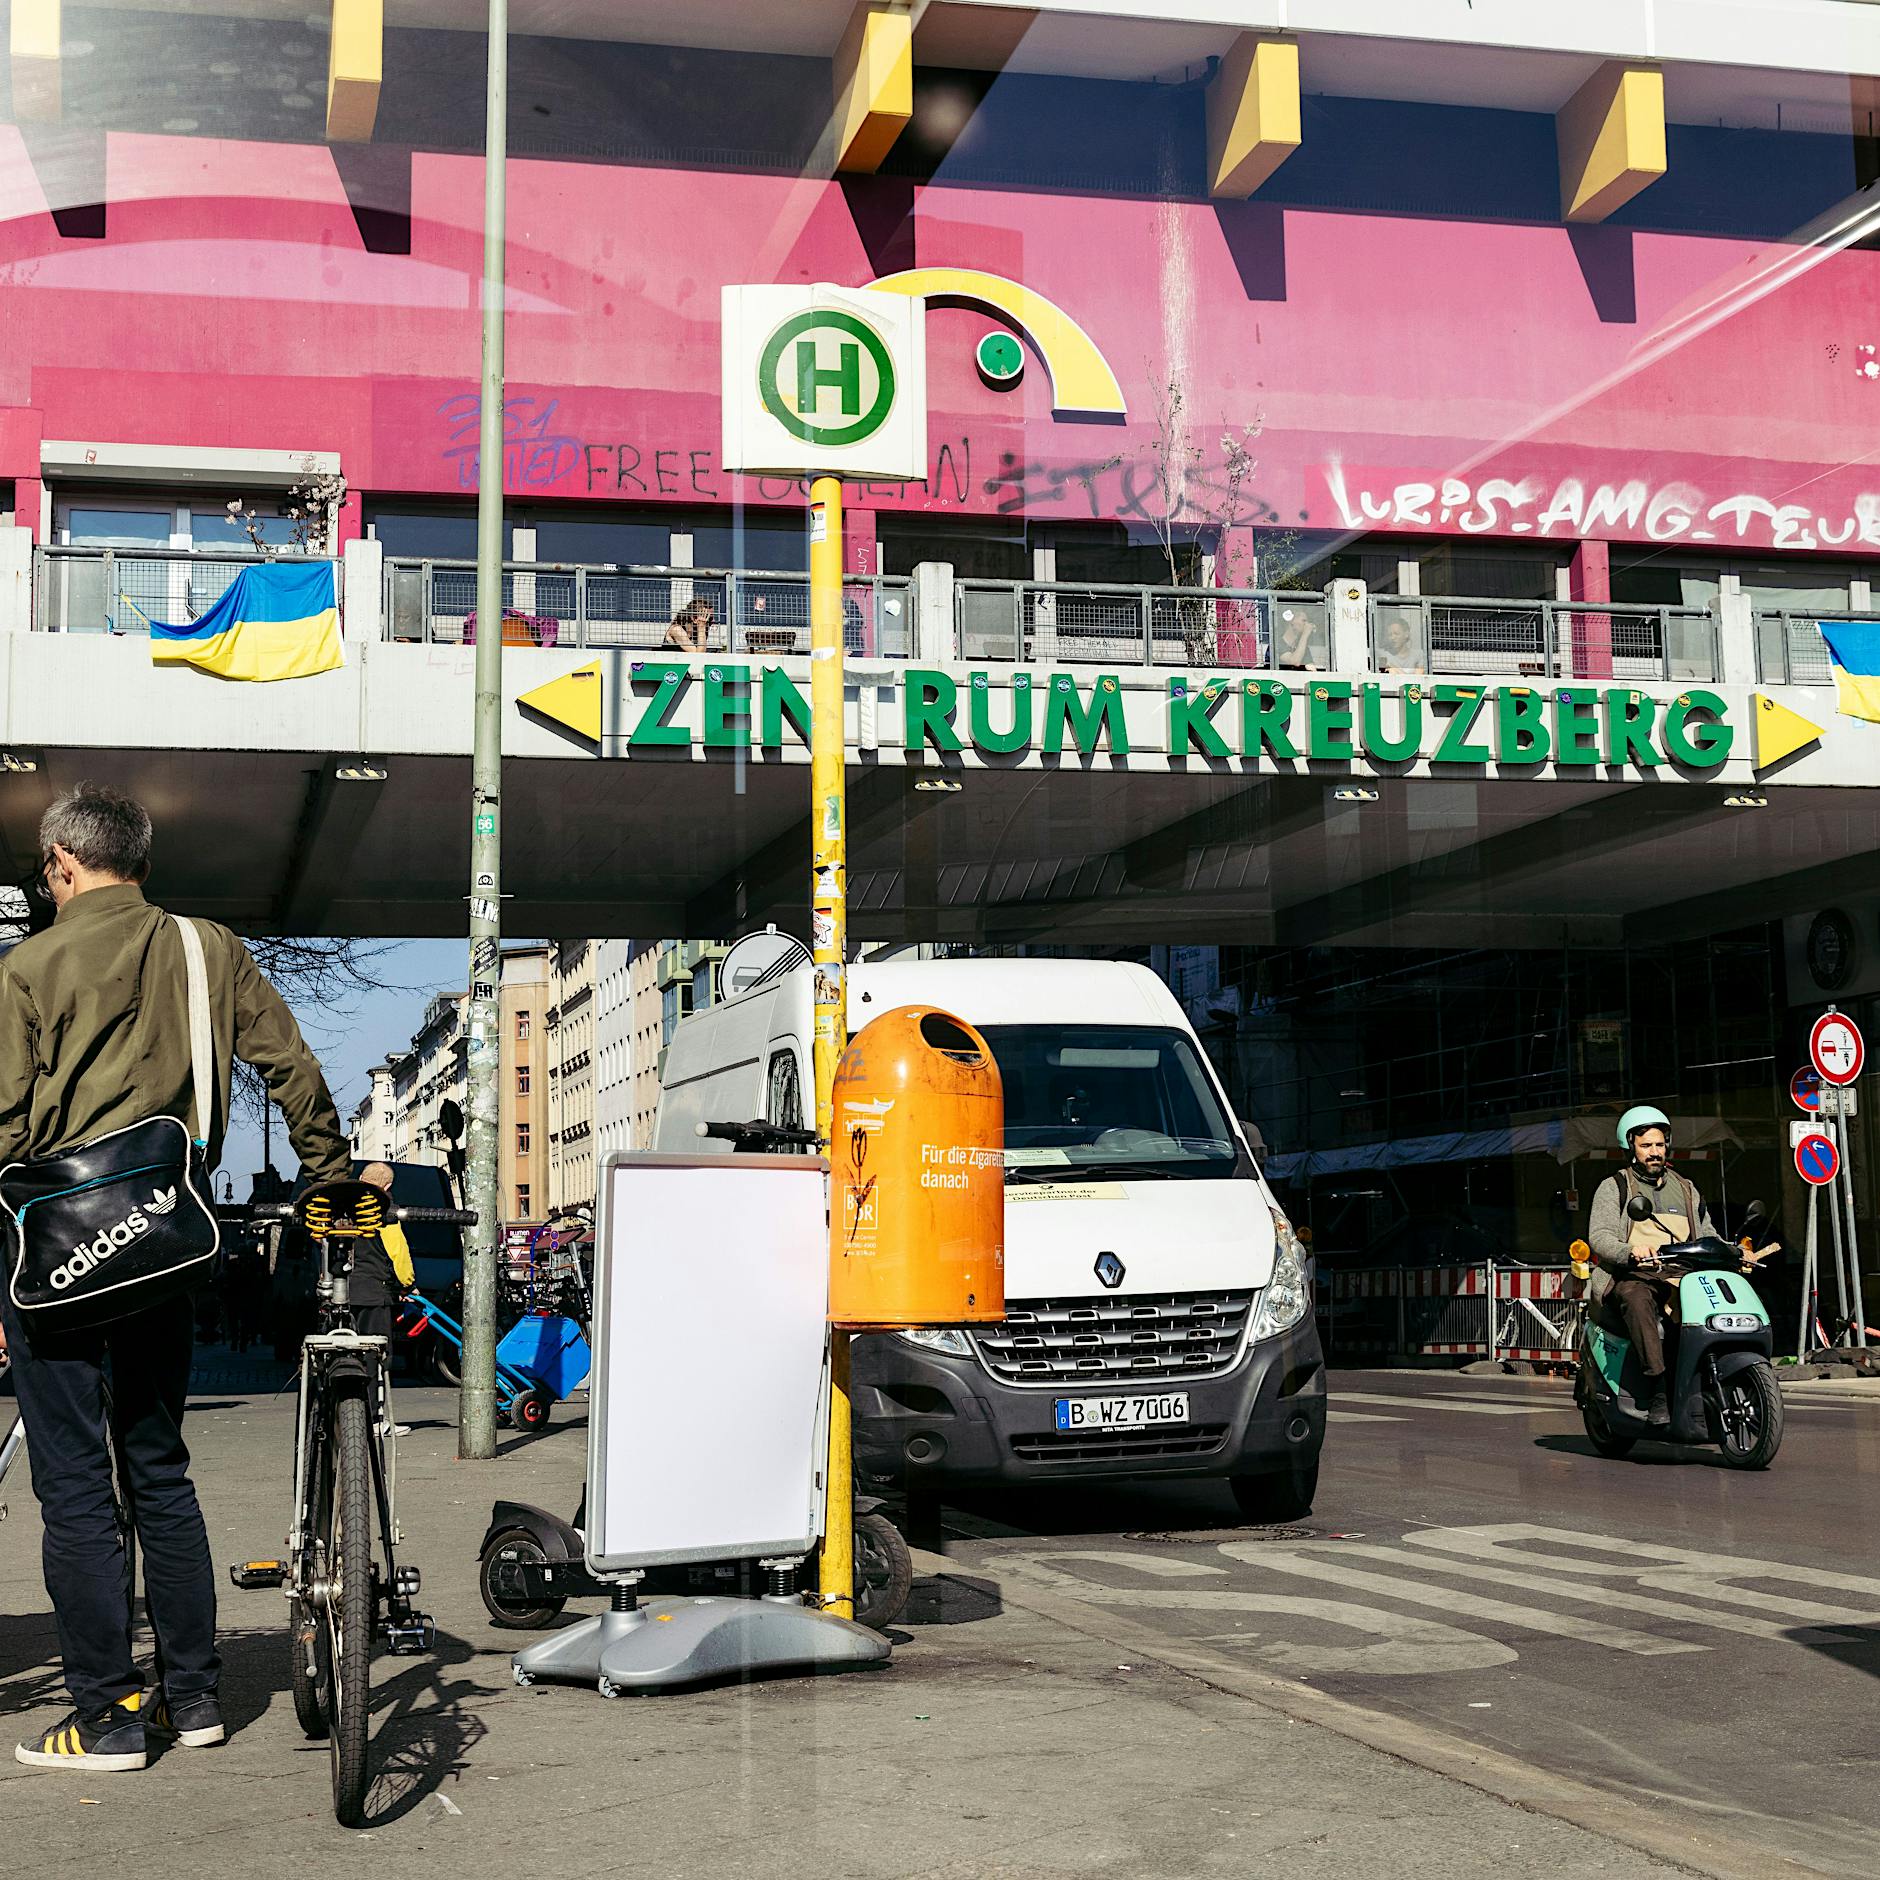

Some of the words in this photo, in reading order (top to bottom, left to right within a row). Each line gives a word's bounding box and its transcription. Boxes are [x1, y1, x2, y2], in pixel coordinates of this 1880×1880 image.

[796, 341, 860, 416] H
[584, 444, 718, 498] FREE
[628, 663, 1131, 754] ZENTRUM
[1168, 676, 1734, 768] KREUZBERG
[921, 1144, 945, 1164] Für
[947, 1145, 967, 1165] die
[920, 1168, 969, 1189] danach
[50, 1211, 149, 1290] adidas
[1698, 1276, 1720, 1310] TIER
[1071, 1403, 1085, 1424] B
[1100, 1400, 1128, 1423] WZ
[1133, 1397, 1184, 1420] 7006
